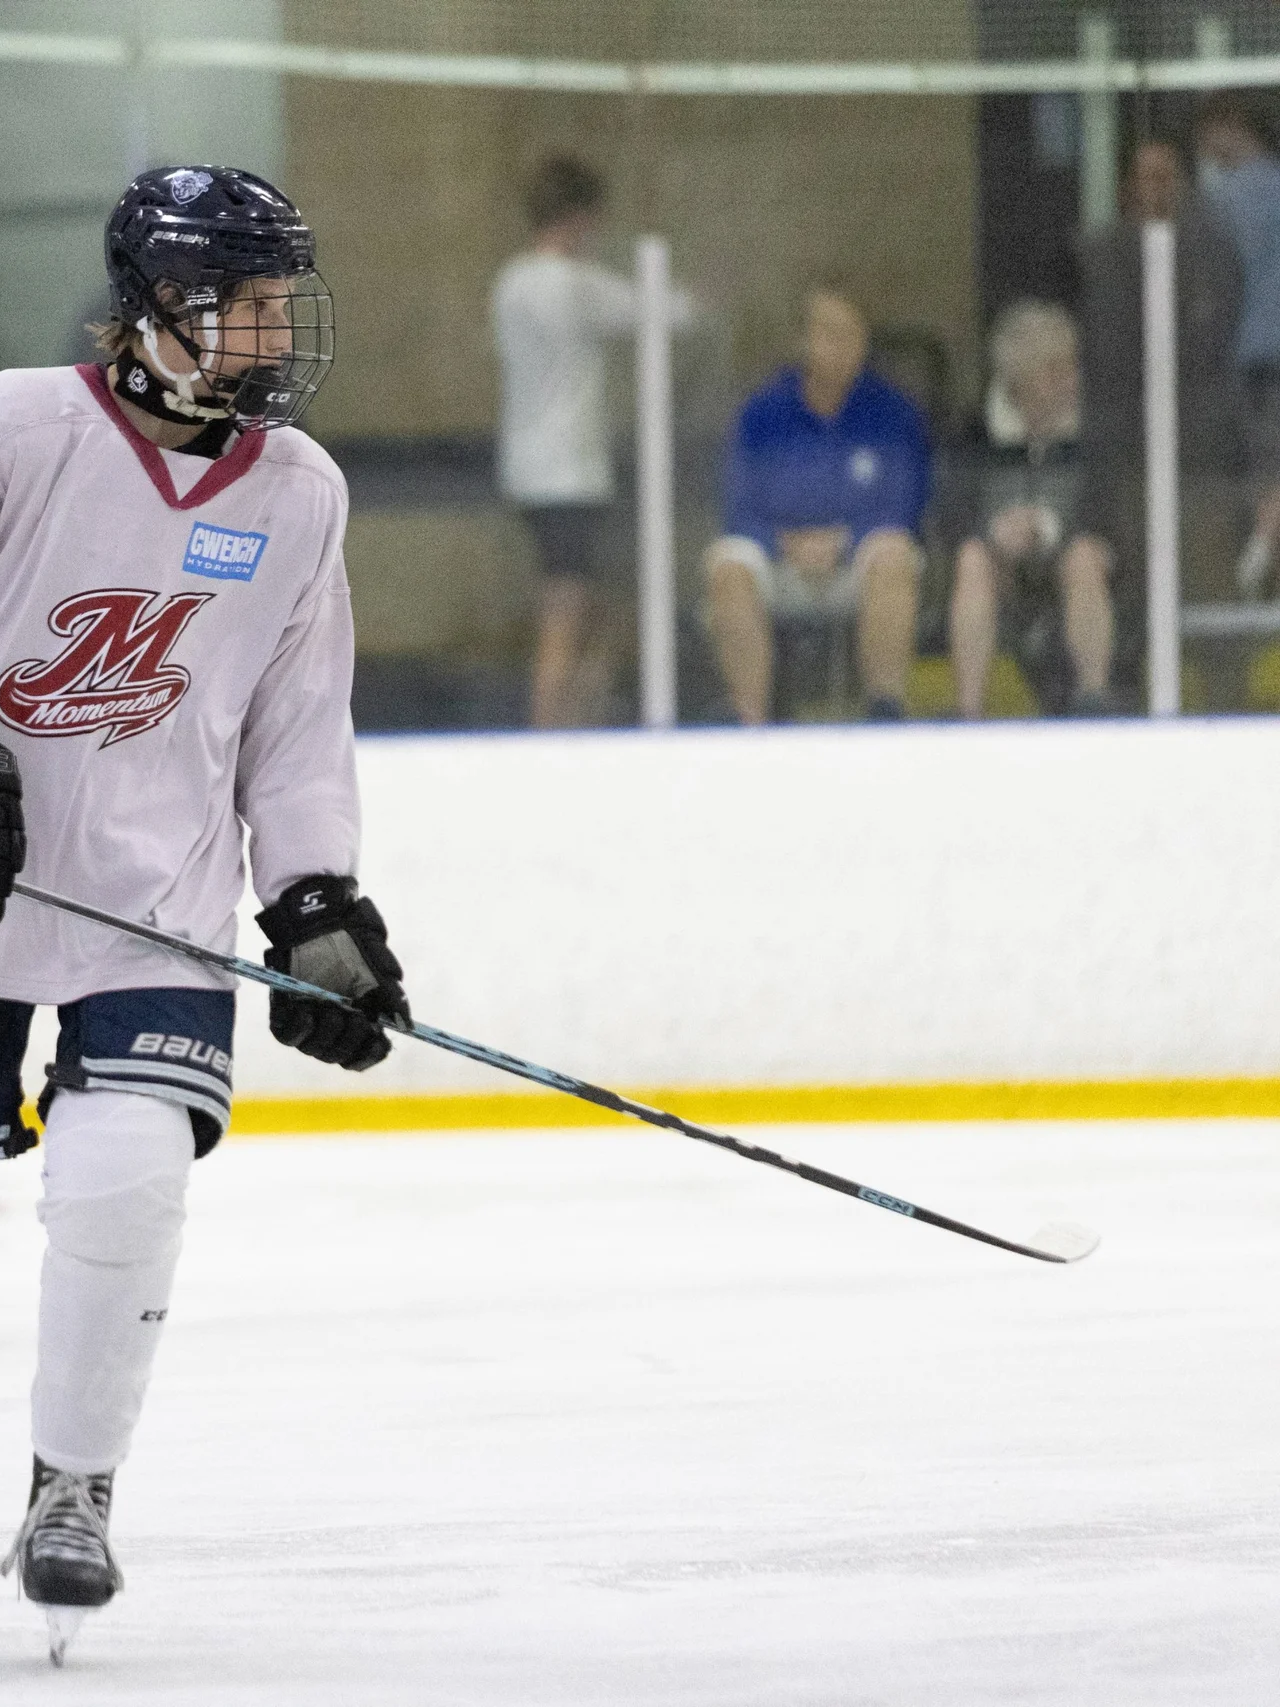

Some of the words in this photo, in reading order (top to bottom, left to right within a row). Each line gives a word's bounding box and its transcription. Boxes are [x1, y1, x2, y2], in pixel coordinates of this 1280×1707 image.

[187, 297, 218, 305] CCM
[11, 587, 218, 699] M
[25, 686, 174, 726] Momentum
